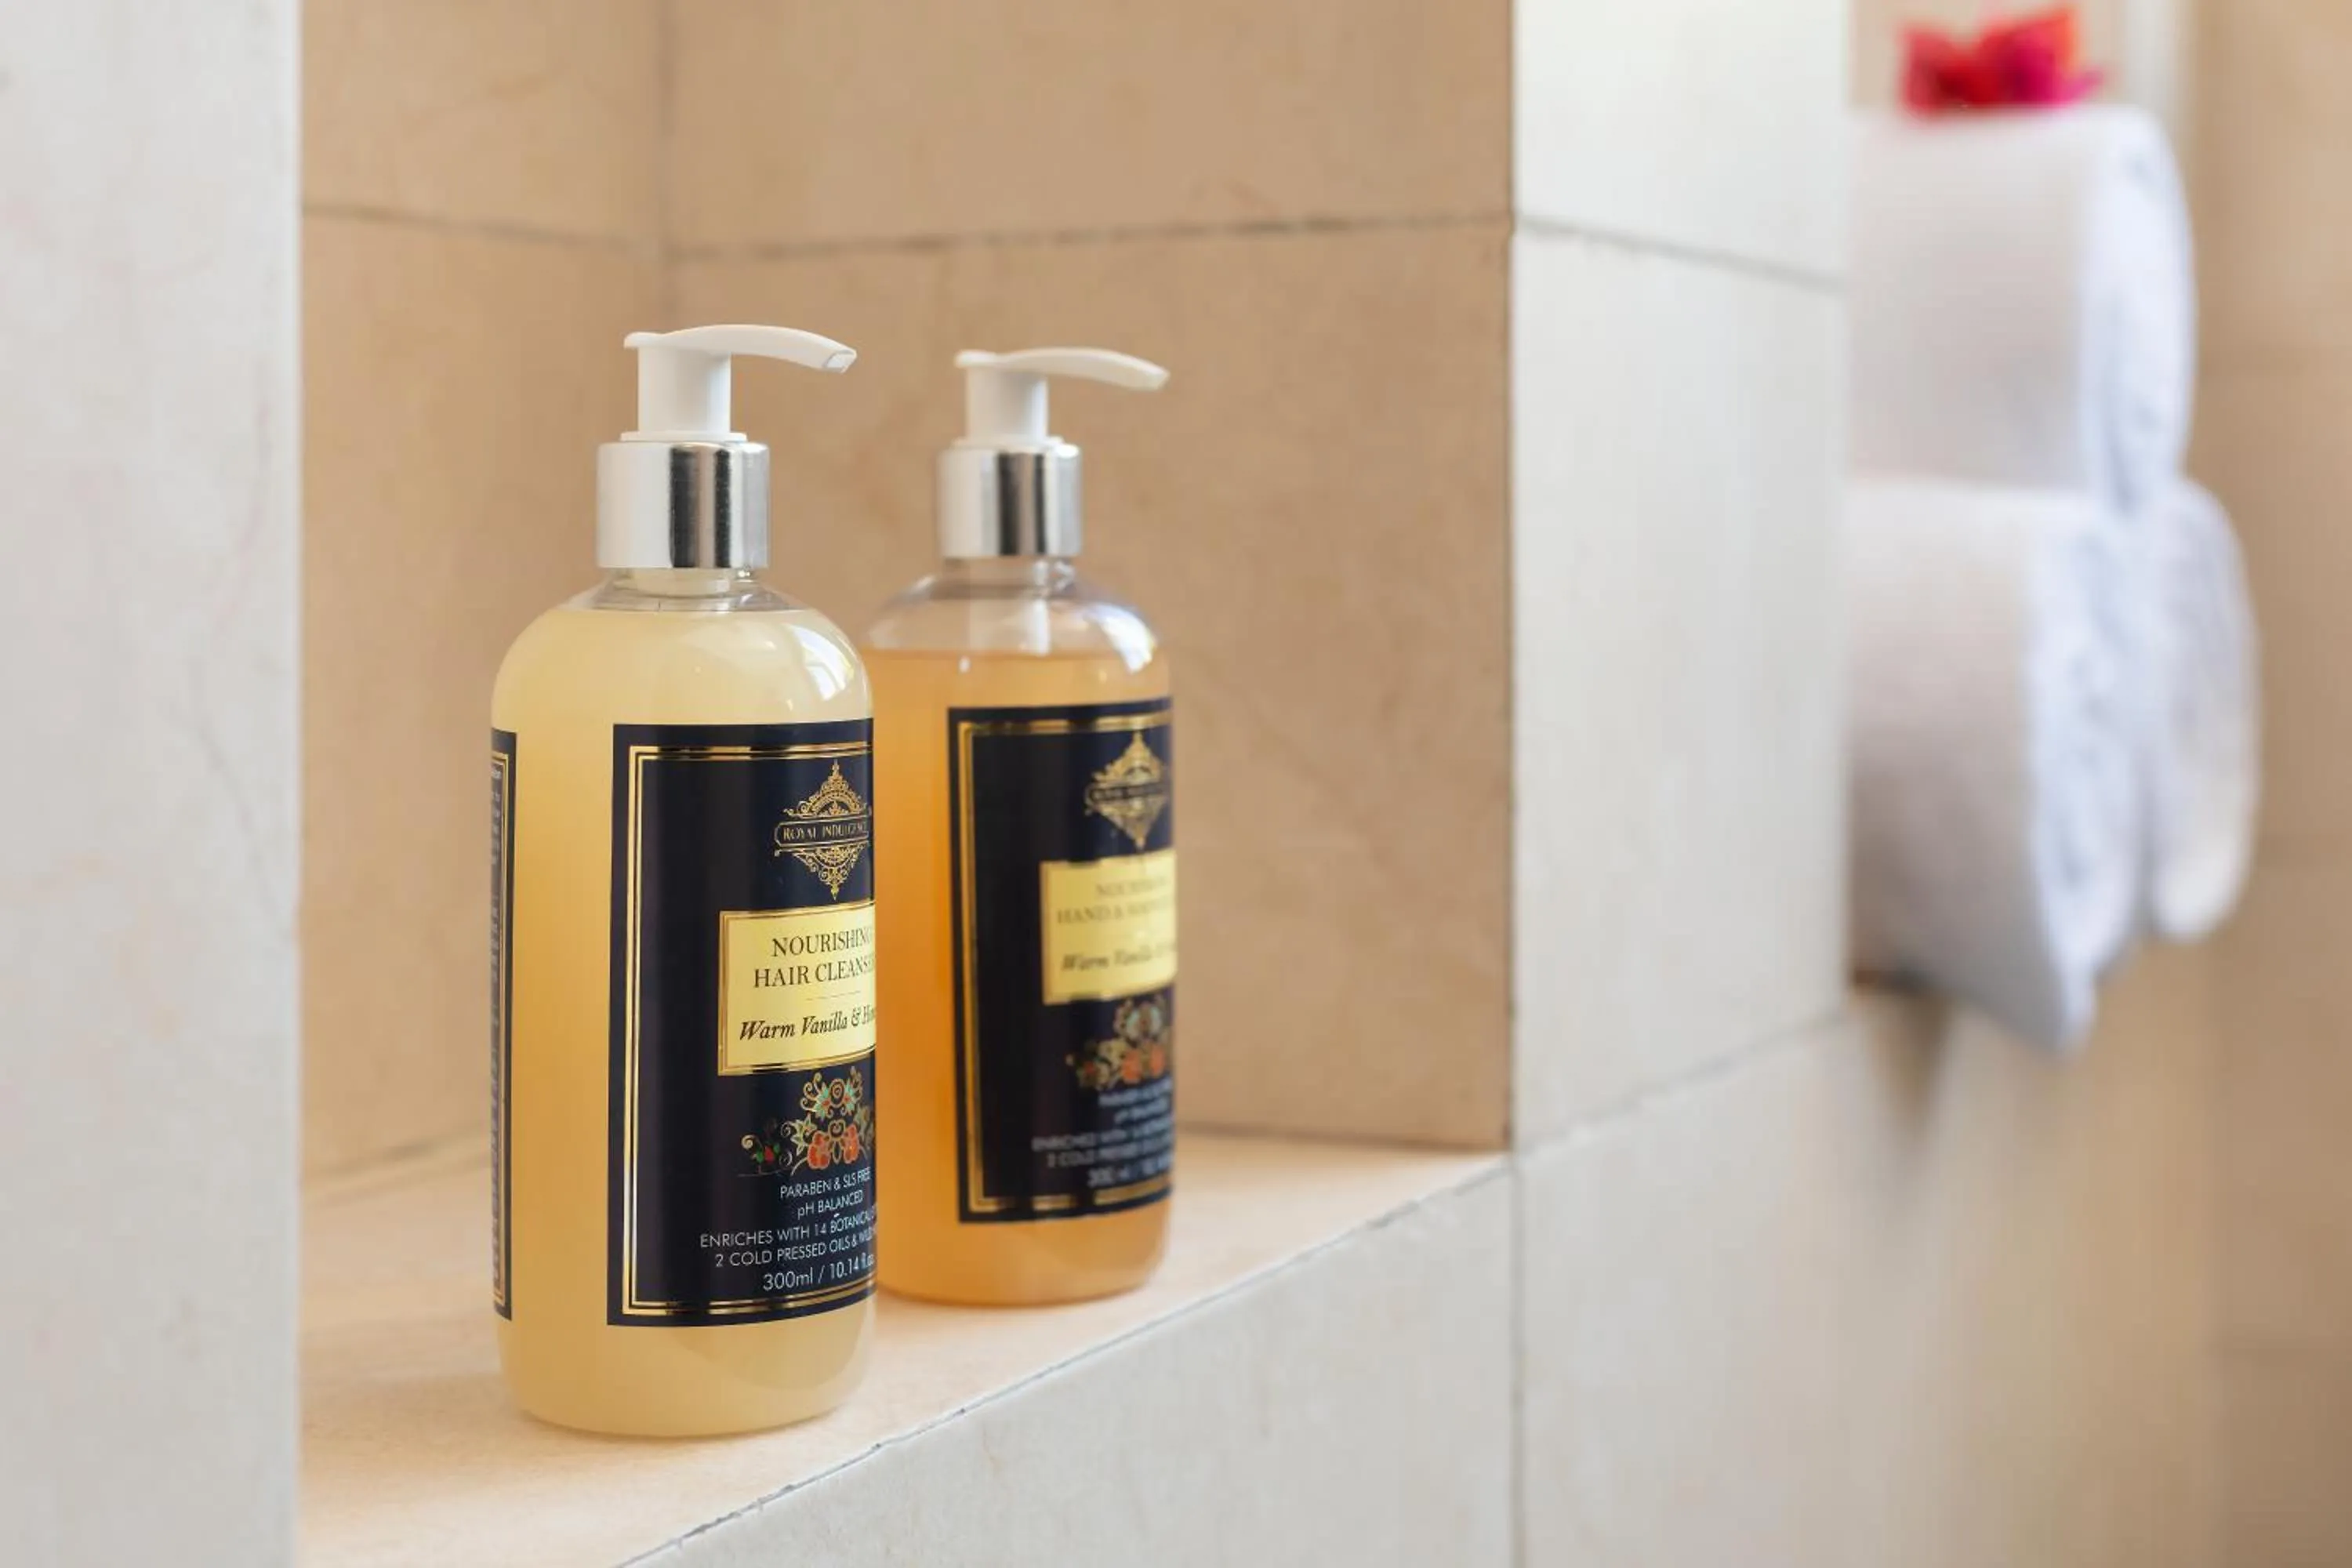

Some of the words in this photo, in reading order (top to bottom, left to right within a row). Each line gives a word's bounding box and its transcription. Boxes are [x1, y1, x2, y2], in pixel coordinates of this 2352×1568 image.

[754, 965, 810, 988] HAIR
[739, 1020, 796, 1040] Warm
[801, 1011, 848, 1035] Vanilla
[851, 1007, 862, 1026] &
[780, 1180, 831, 1199] PARABEN
[833, 1177, 841, 1190] &
[843, 1172, 857, 1188] SLS
[797, 1202, 815, 1220] pH
[818, 1189, 863, 1213] BALANCED
[700, 1230, 774, 1247] ENRICHES
[777, 1225, 810, 1241] WITH
[815, 1223, 826, 1236] 14
[714, 1254, 724, 1268] 2
[729, 1250, 772, 1267] COLD
[777, 1242, 826, 1261] PRESSED
[829, 1236, 850, 1254] OILS
[851, 1233, 857, 1247] &
[763, 1267, 813, 1291] 300ml
[818, 1265, 826, 1284] /
[829, 1256, 858, 1279] 10.14
